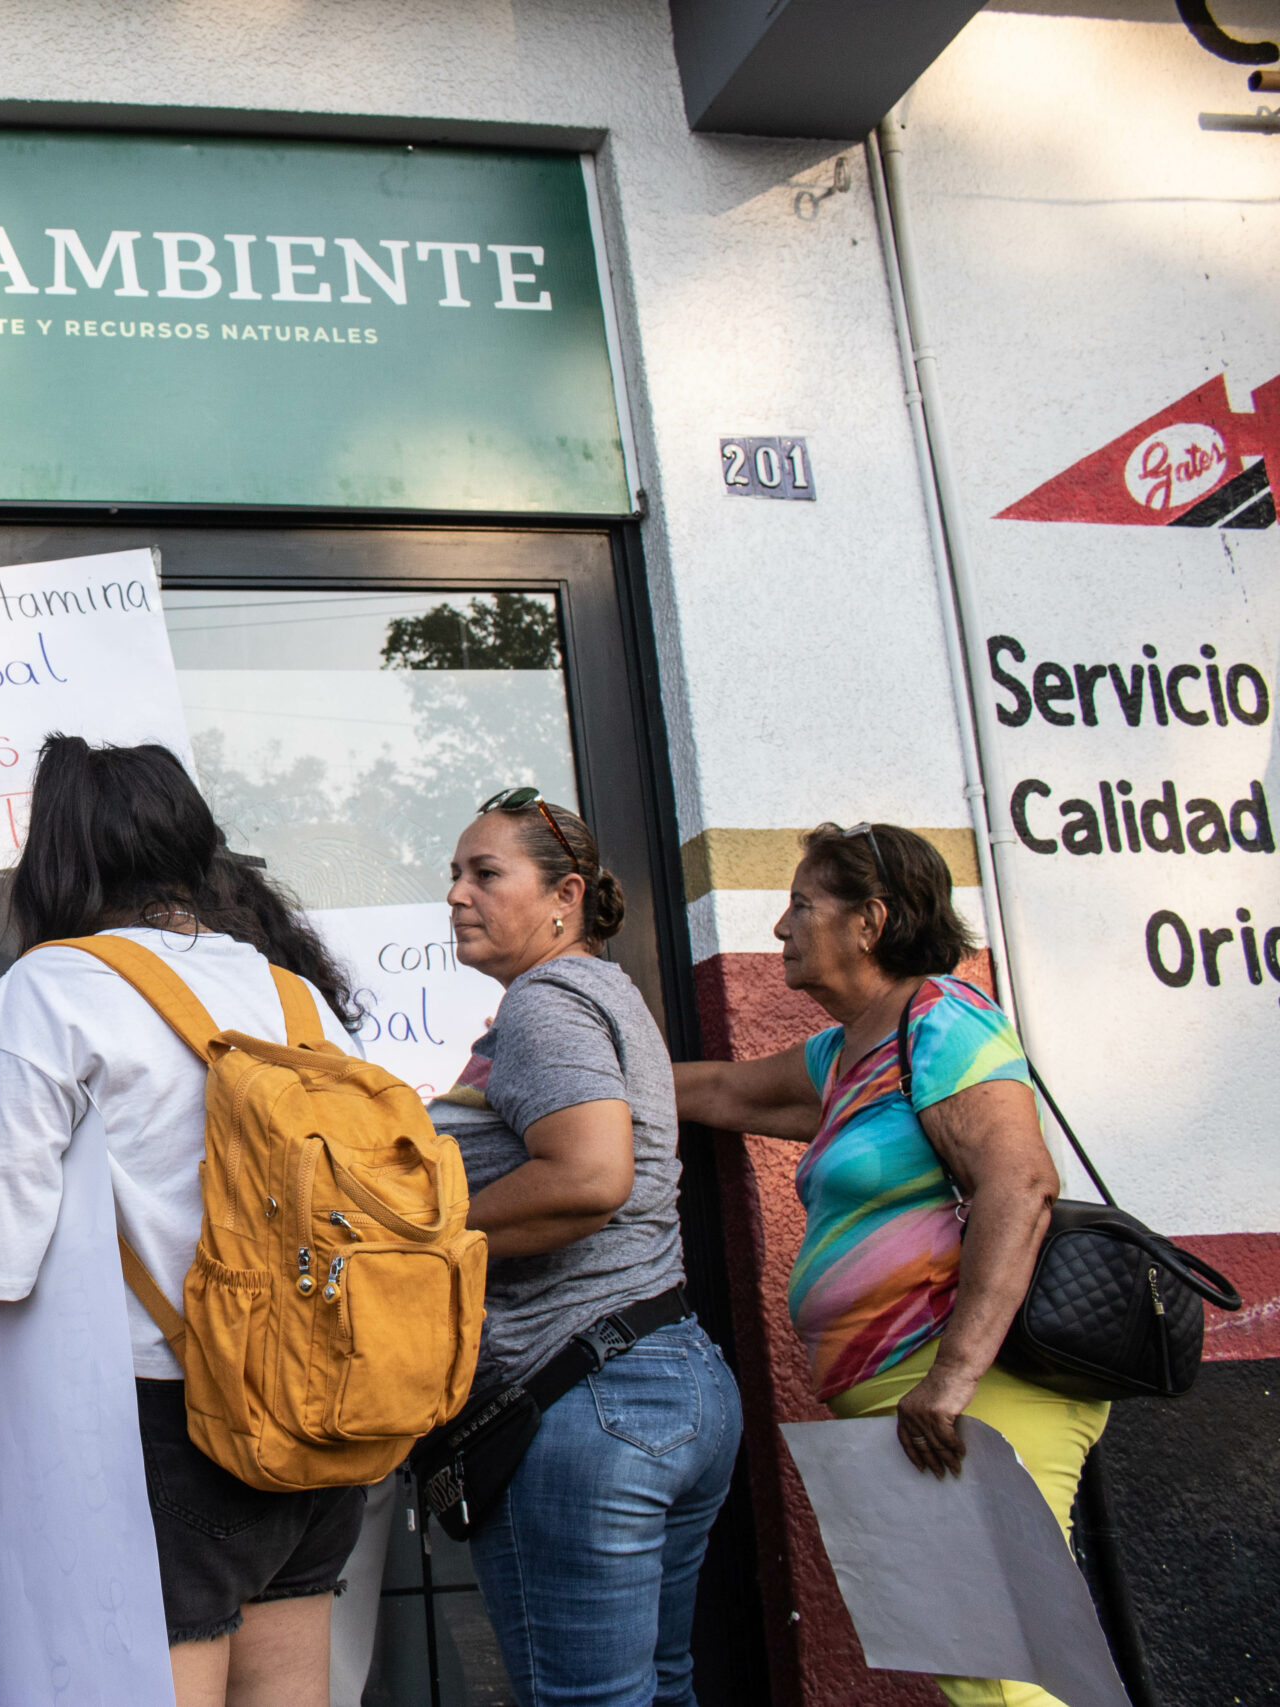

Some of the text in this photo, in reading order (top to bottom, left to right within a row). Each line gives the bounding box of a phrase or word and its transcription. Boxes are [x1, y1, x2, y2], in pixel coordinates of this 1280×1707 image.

[37, 319, 53, 335] Y
[65, 320, 210, 339] RECURSOS
[221, 323, 379, 344] NATURALES
[722, 443, 809, 489] 201
[986, 634, 1271, 727] Servicio
[1010, 778, 1277, 855] Calidad
[353, 986, 445, 1046] Sal
